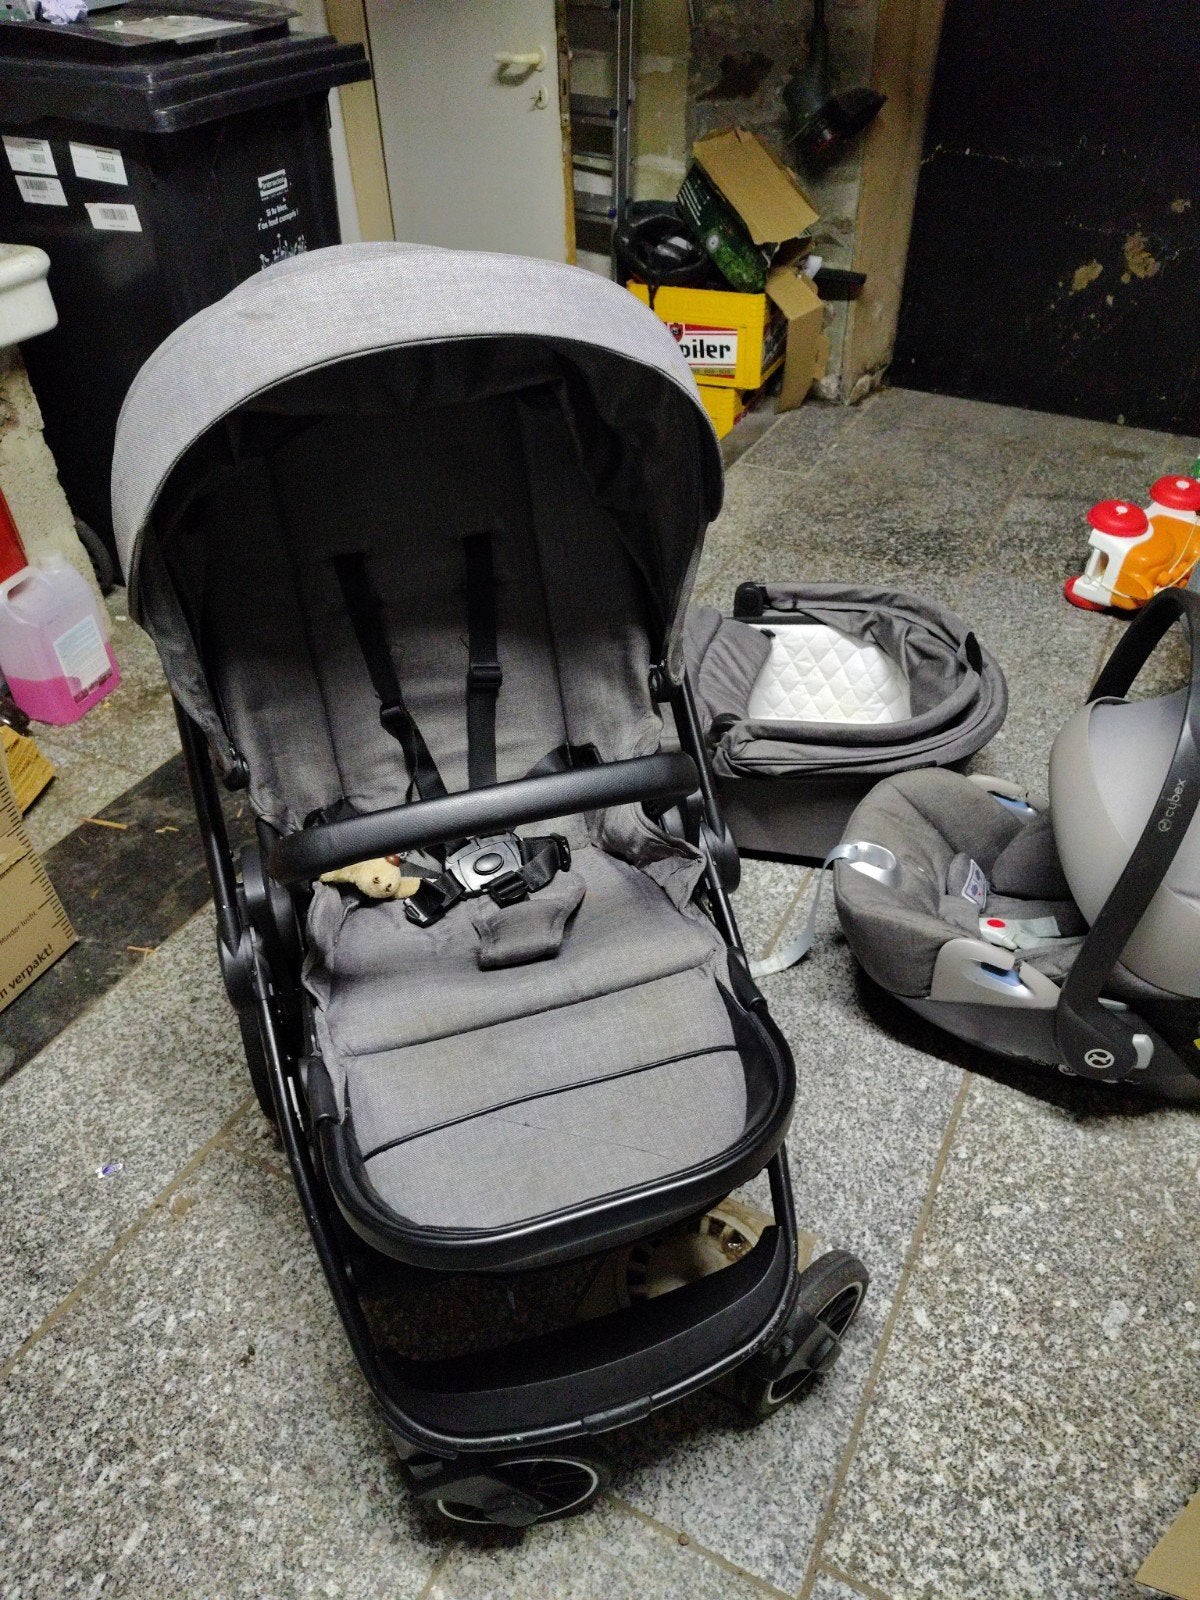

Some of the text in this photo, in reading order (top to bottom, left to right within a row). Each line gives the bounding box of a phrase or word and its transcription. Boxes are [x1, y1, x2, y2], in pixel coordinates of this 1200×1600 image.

[1166, 778, 1186, 817] cybex
[20, 910, 37, 926] lucht
[8, 944, 54, 989] verpakt!
